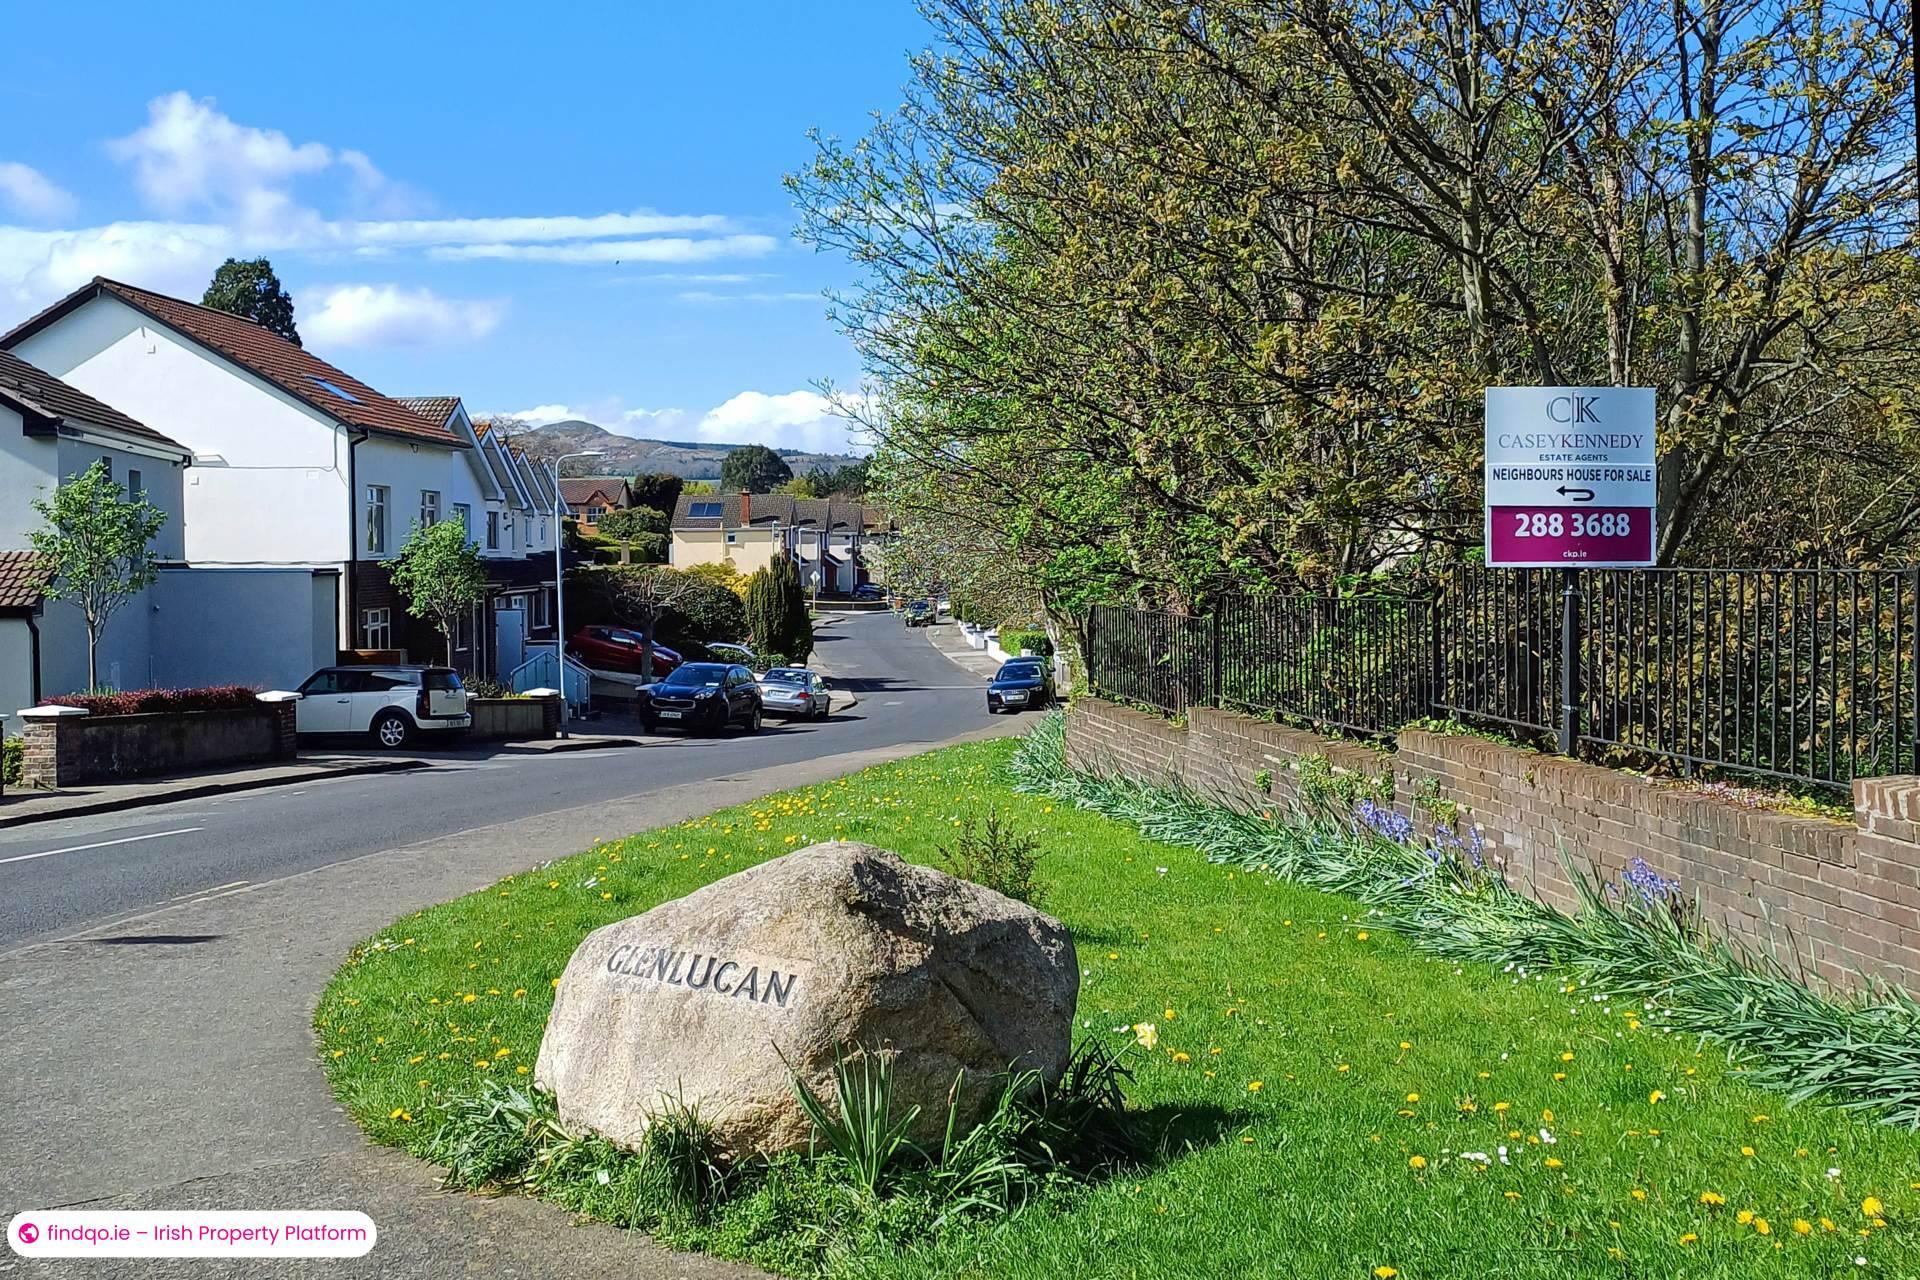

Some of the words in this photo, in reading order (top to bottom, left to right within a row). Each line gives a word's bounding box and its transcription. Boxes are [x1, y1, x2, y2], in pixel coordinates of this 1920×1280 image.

[1539, 454, 1573, 462] ESTATE
[1575, 454, 1608, 462] AGENTS
[1493, 468, 1563, 481] NEIGHBOURS
[1567, 469, 1601, 481] HOUSE
[1604, 469, 1624, 481] FOR
[1626, 470, 1651, 482] SALE
[1514, 513, 1564, 537] 288
[1570, 513, 1630, 537] 3688
[606, 944, 797, 1007] GLENLUCAN
